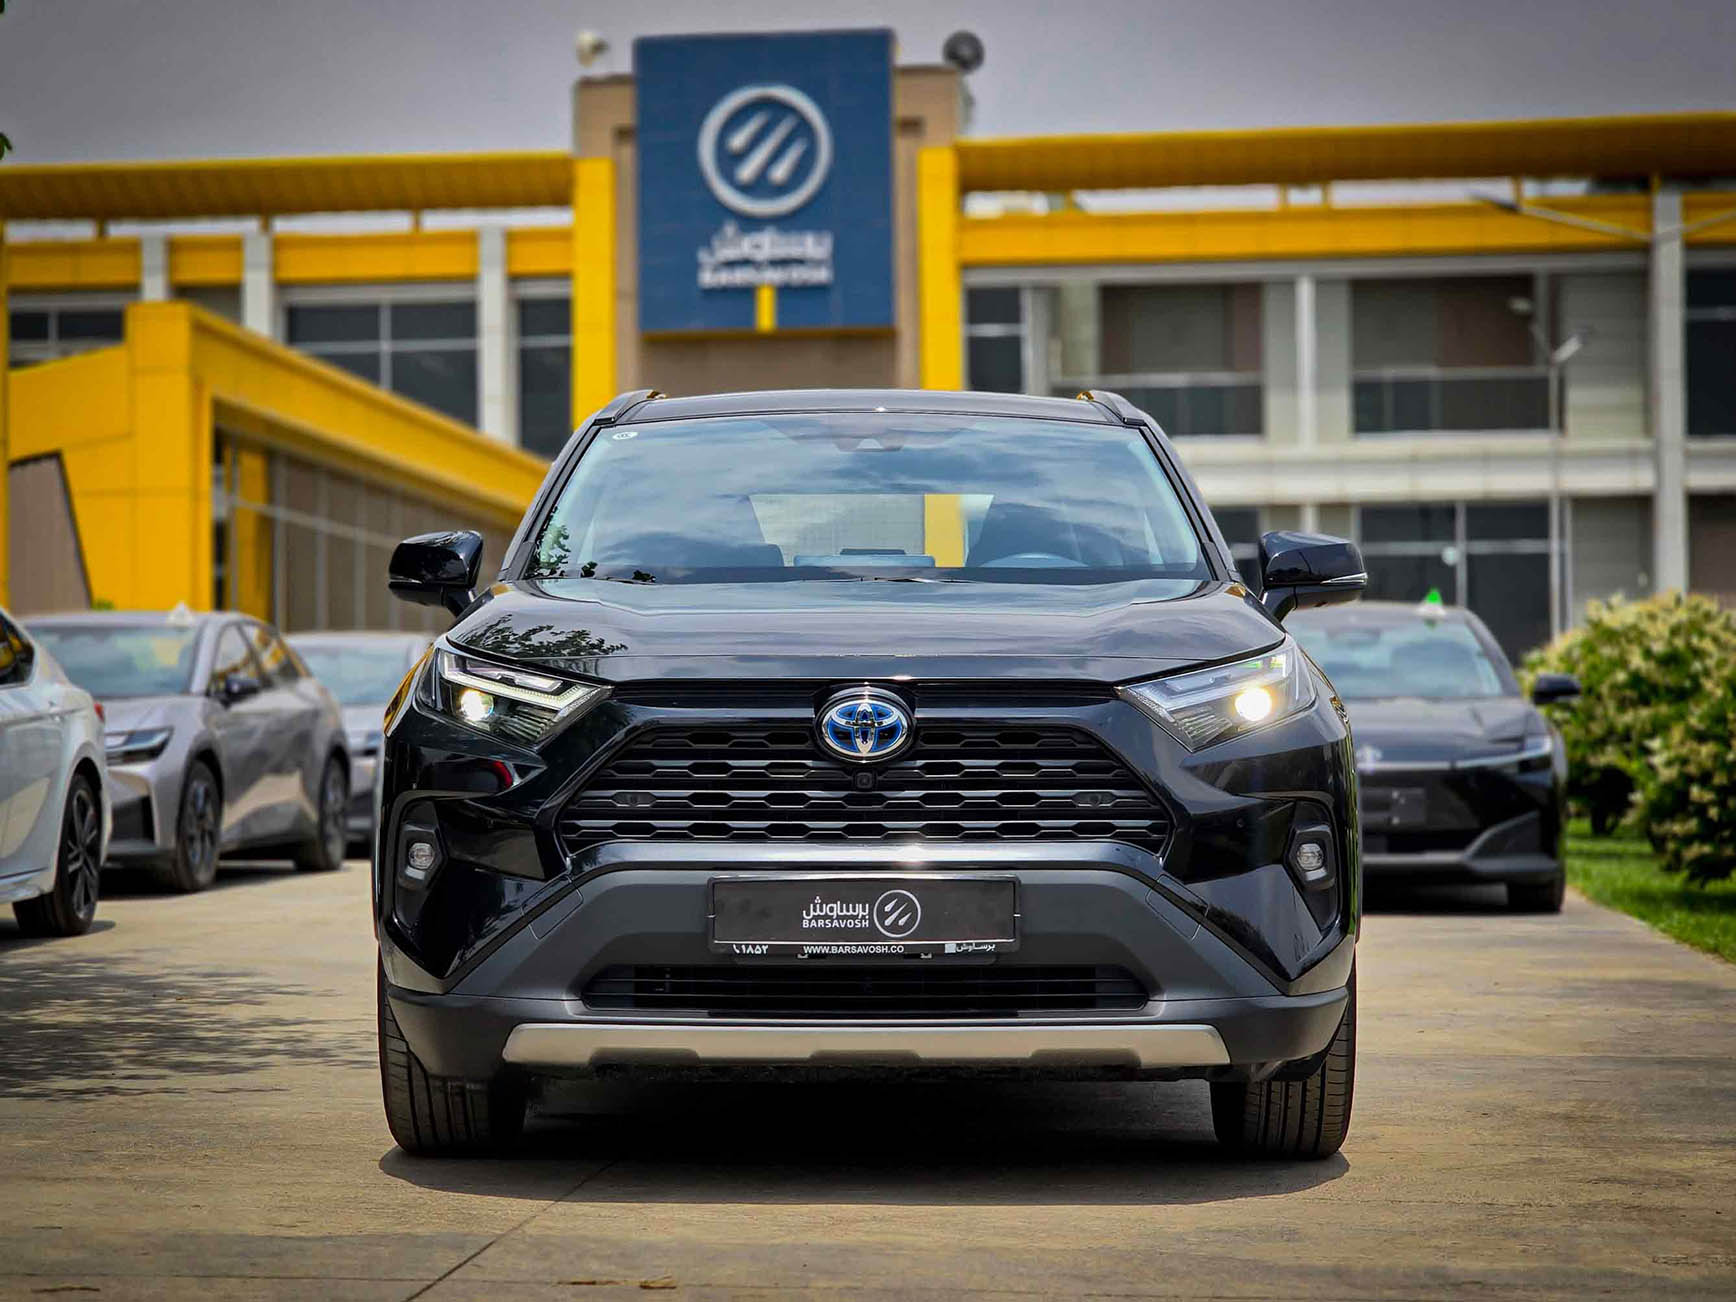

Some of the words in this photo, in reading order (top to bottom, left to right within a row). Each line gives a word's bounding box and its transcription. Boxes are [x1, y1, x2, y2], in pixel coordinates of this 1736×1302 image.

[803, 896, 869, 919] برساوش
[803, 920, 869, 928] BARSAVOSH
[803, 945, 905, 954] WWW.BARSAVOSH.CO
